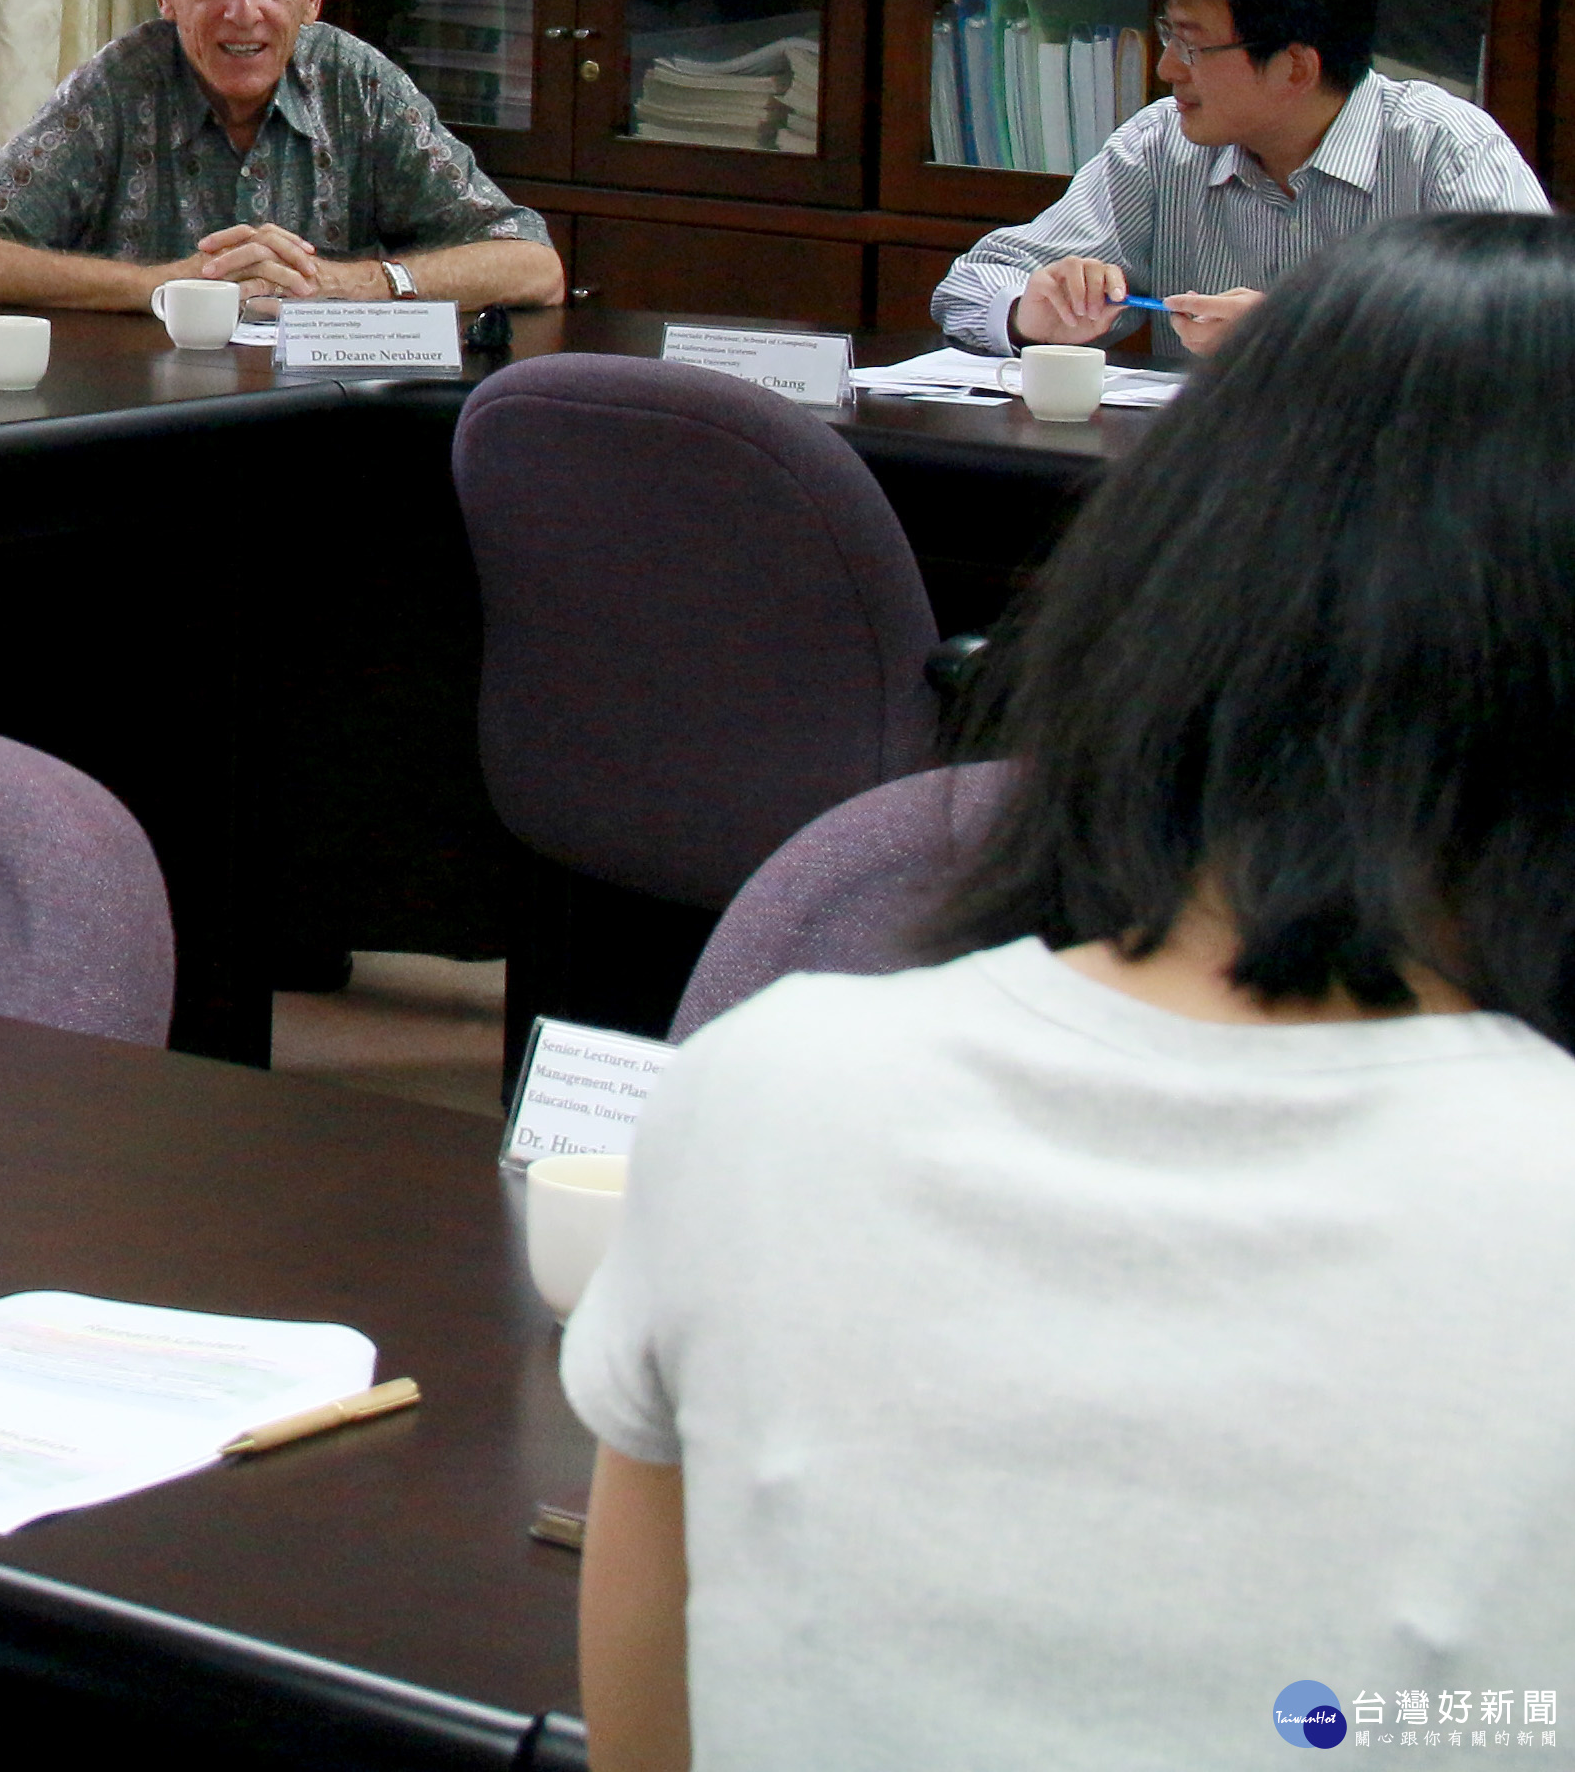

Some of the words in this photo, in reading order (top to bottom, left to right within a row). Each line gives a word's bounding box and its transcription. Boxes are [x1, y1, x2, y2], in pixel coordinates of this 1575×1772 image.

[311, 350, 331, 361] Dr.
[335, 350, 376, 361] Deane
[380, 350, 443, 361] Neubauer
[762, 375, 806, 391] Chang
[541, 1037, 580, 1057] Senior
[583, 1048, 640, 1072] Lecturer,
[534, 1063, 617, 1096] Management,
[527, 1089, 590, 1116] Education,
[517, 1127, 544, 1151] Dr.
